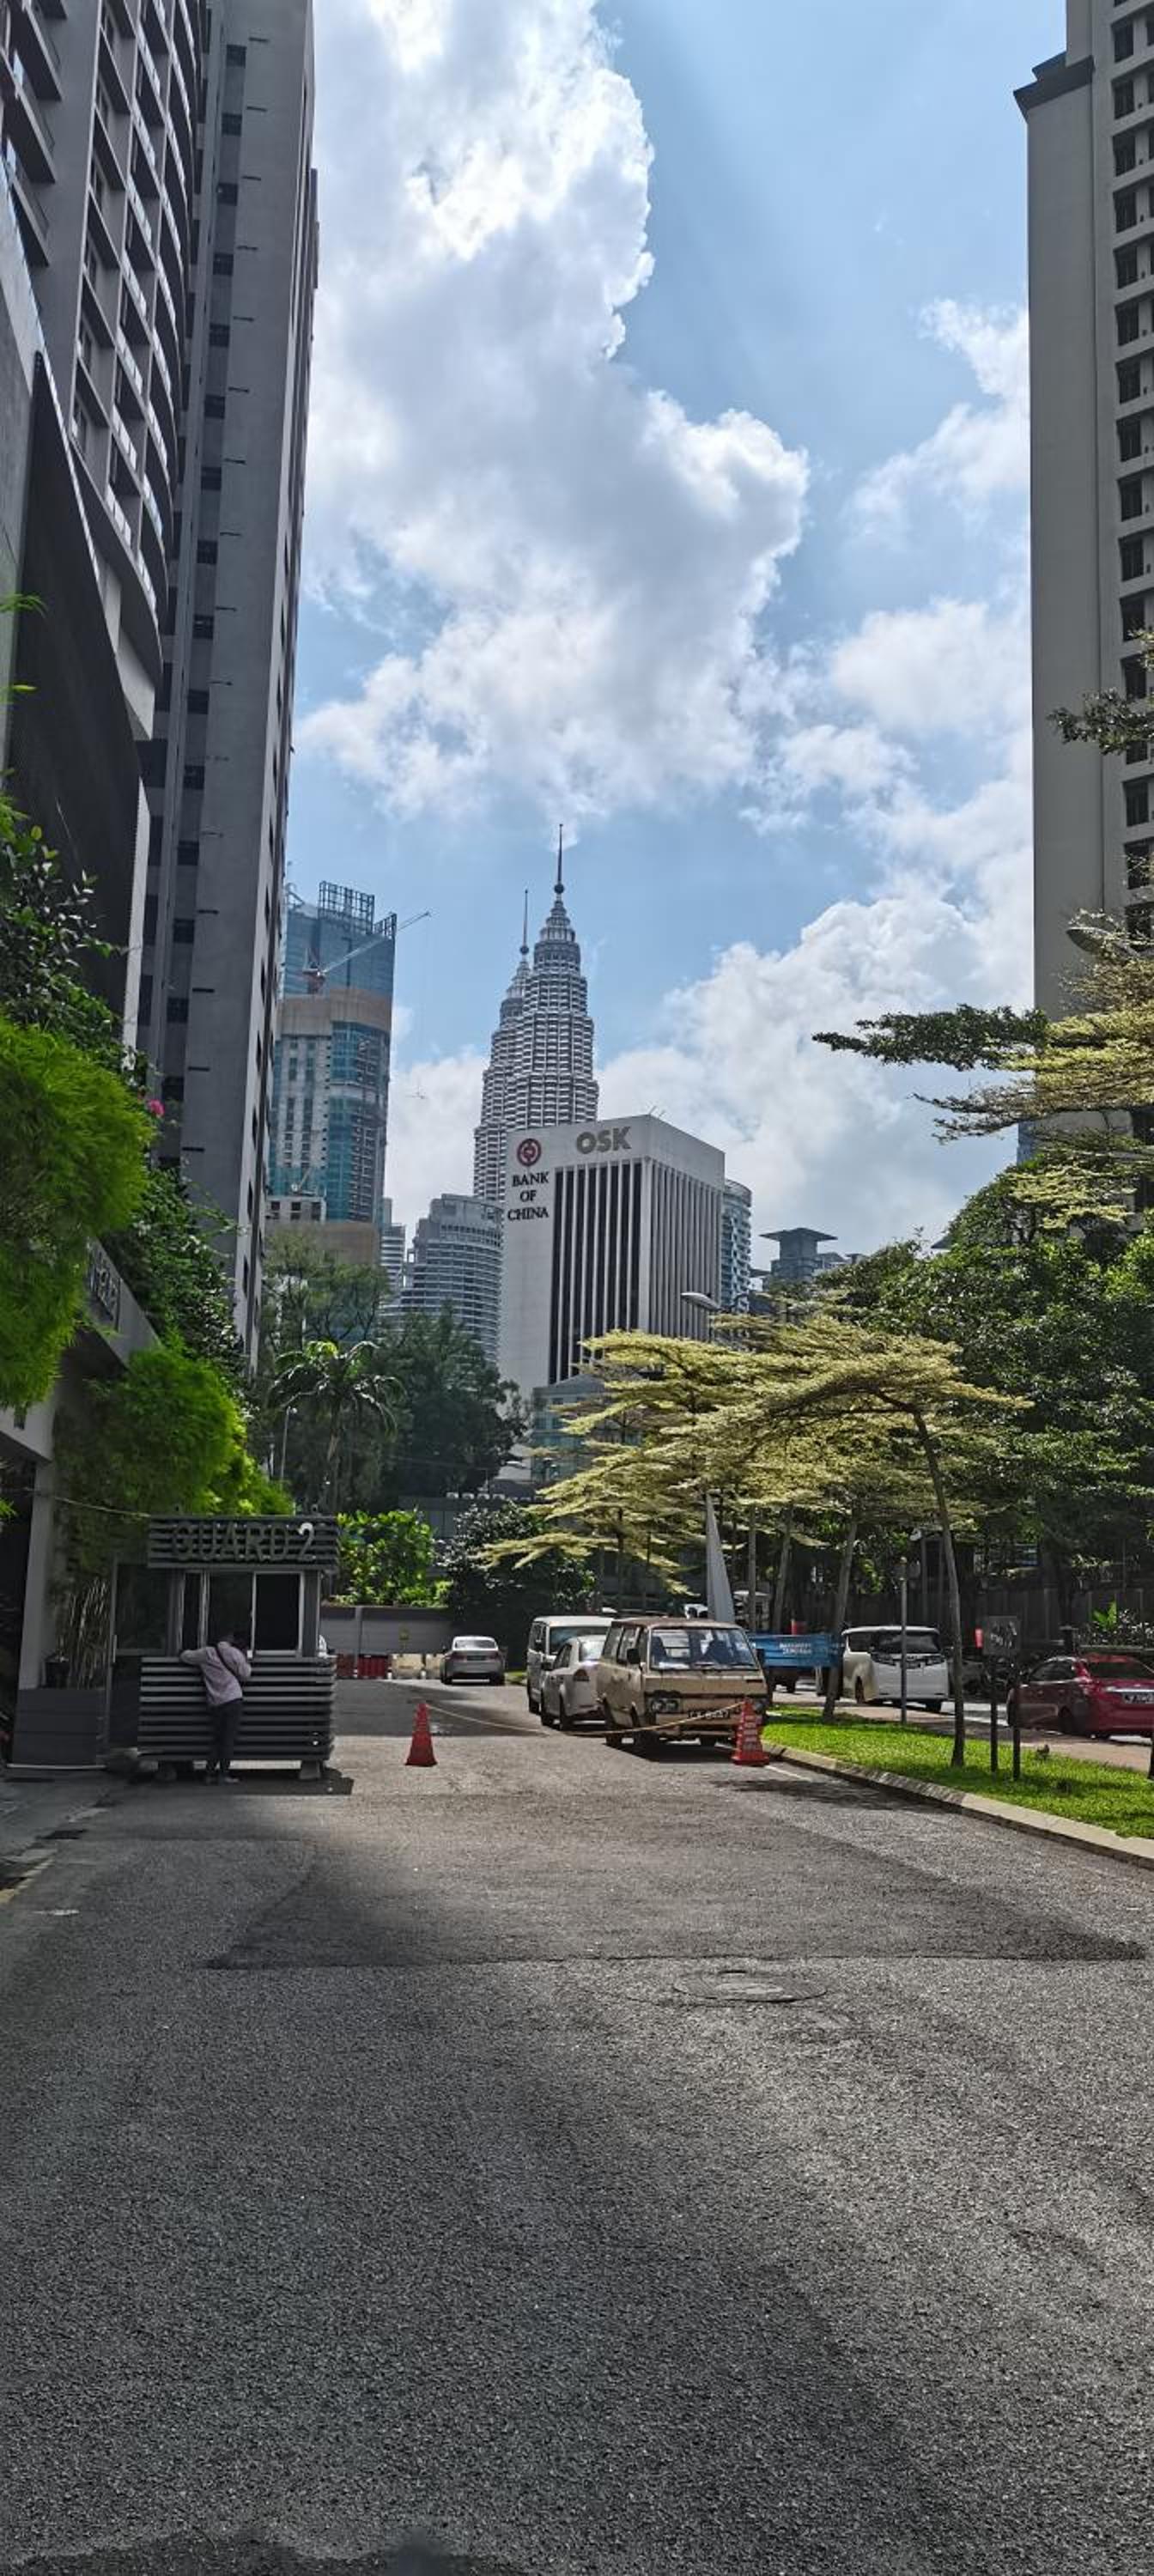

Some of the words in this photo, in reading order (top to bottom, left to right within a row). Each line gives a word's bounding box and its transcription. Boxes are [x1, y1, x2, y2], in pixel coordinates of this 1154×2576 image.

[576, 1126, 631, 1154] OSK
[513, 1172, 550, 1187] BANK
[519, 1190, 538, 1202] OF
[507, 1207, 550, 1222] CHINA
[173, 1522, 289, 1561] GUARD
[297, 1522, 317, 1561] 2
